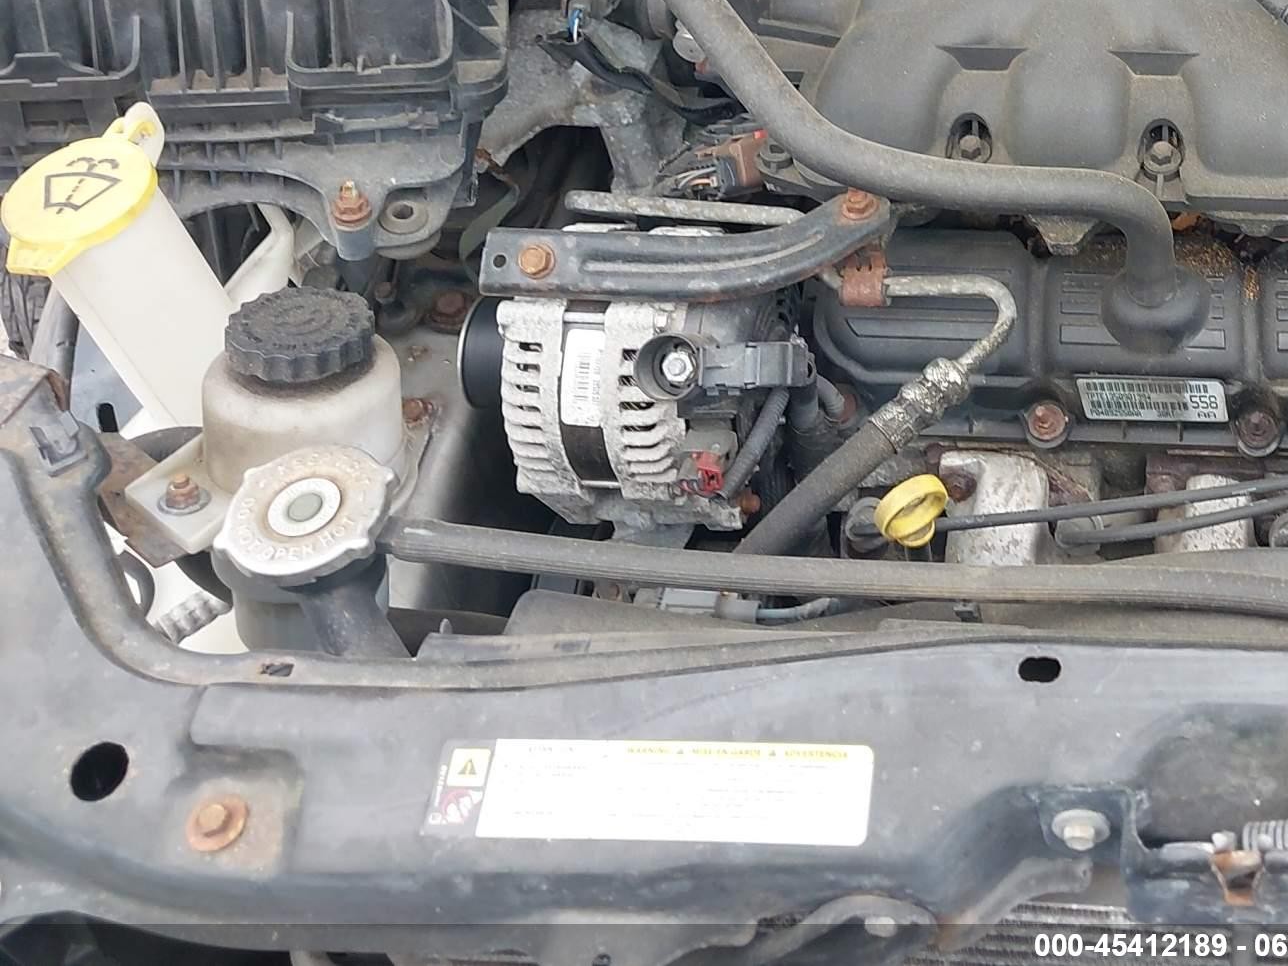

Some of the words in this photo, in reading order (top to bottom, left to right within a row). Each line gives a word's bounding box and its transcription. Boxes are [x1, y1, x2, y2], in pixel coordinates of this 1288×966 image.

[1189, 394, 1219, 410] 558
[260, 545, 314, 562] OPEN
[318, 515, 355, 547] HOT
